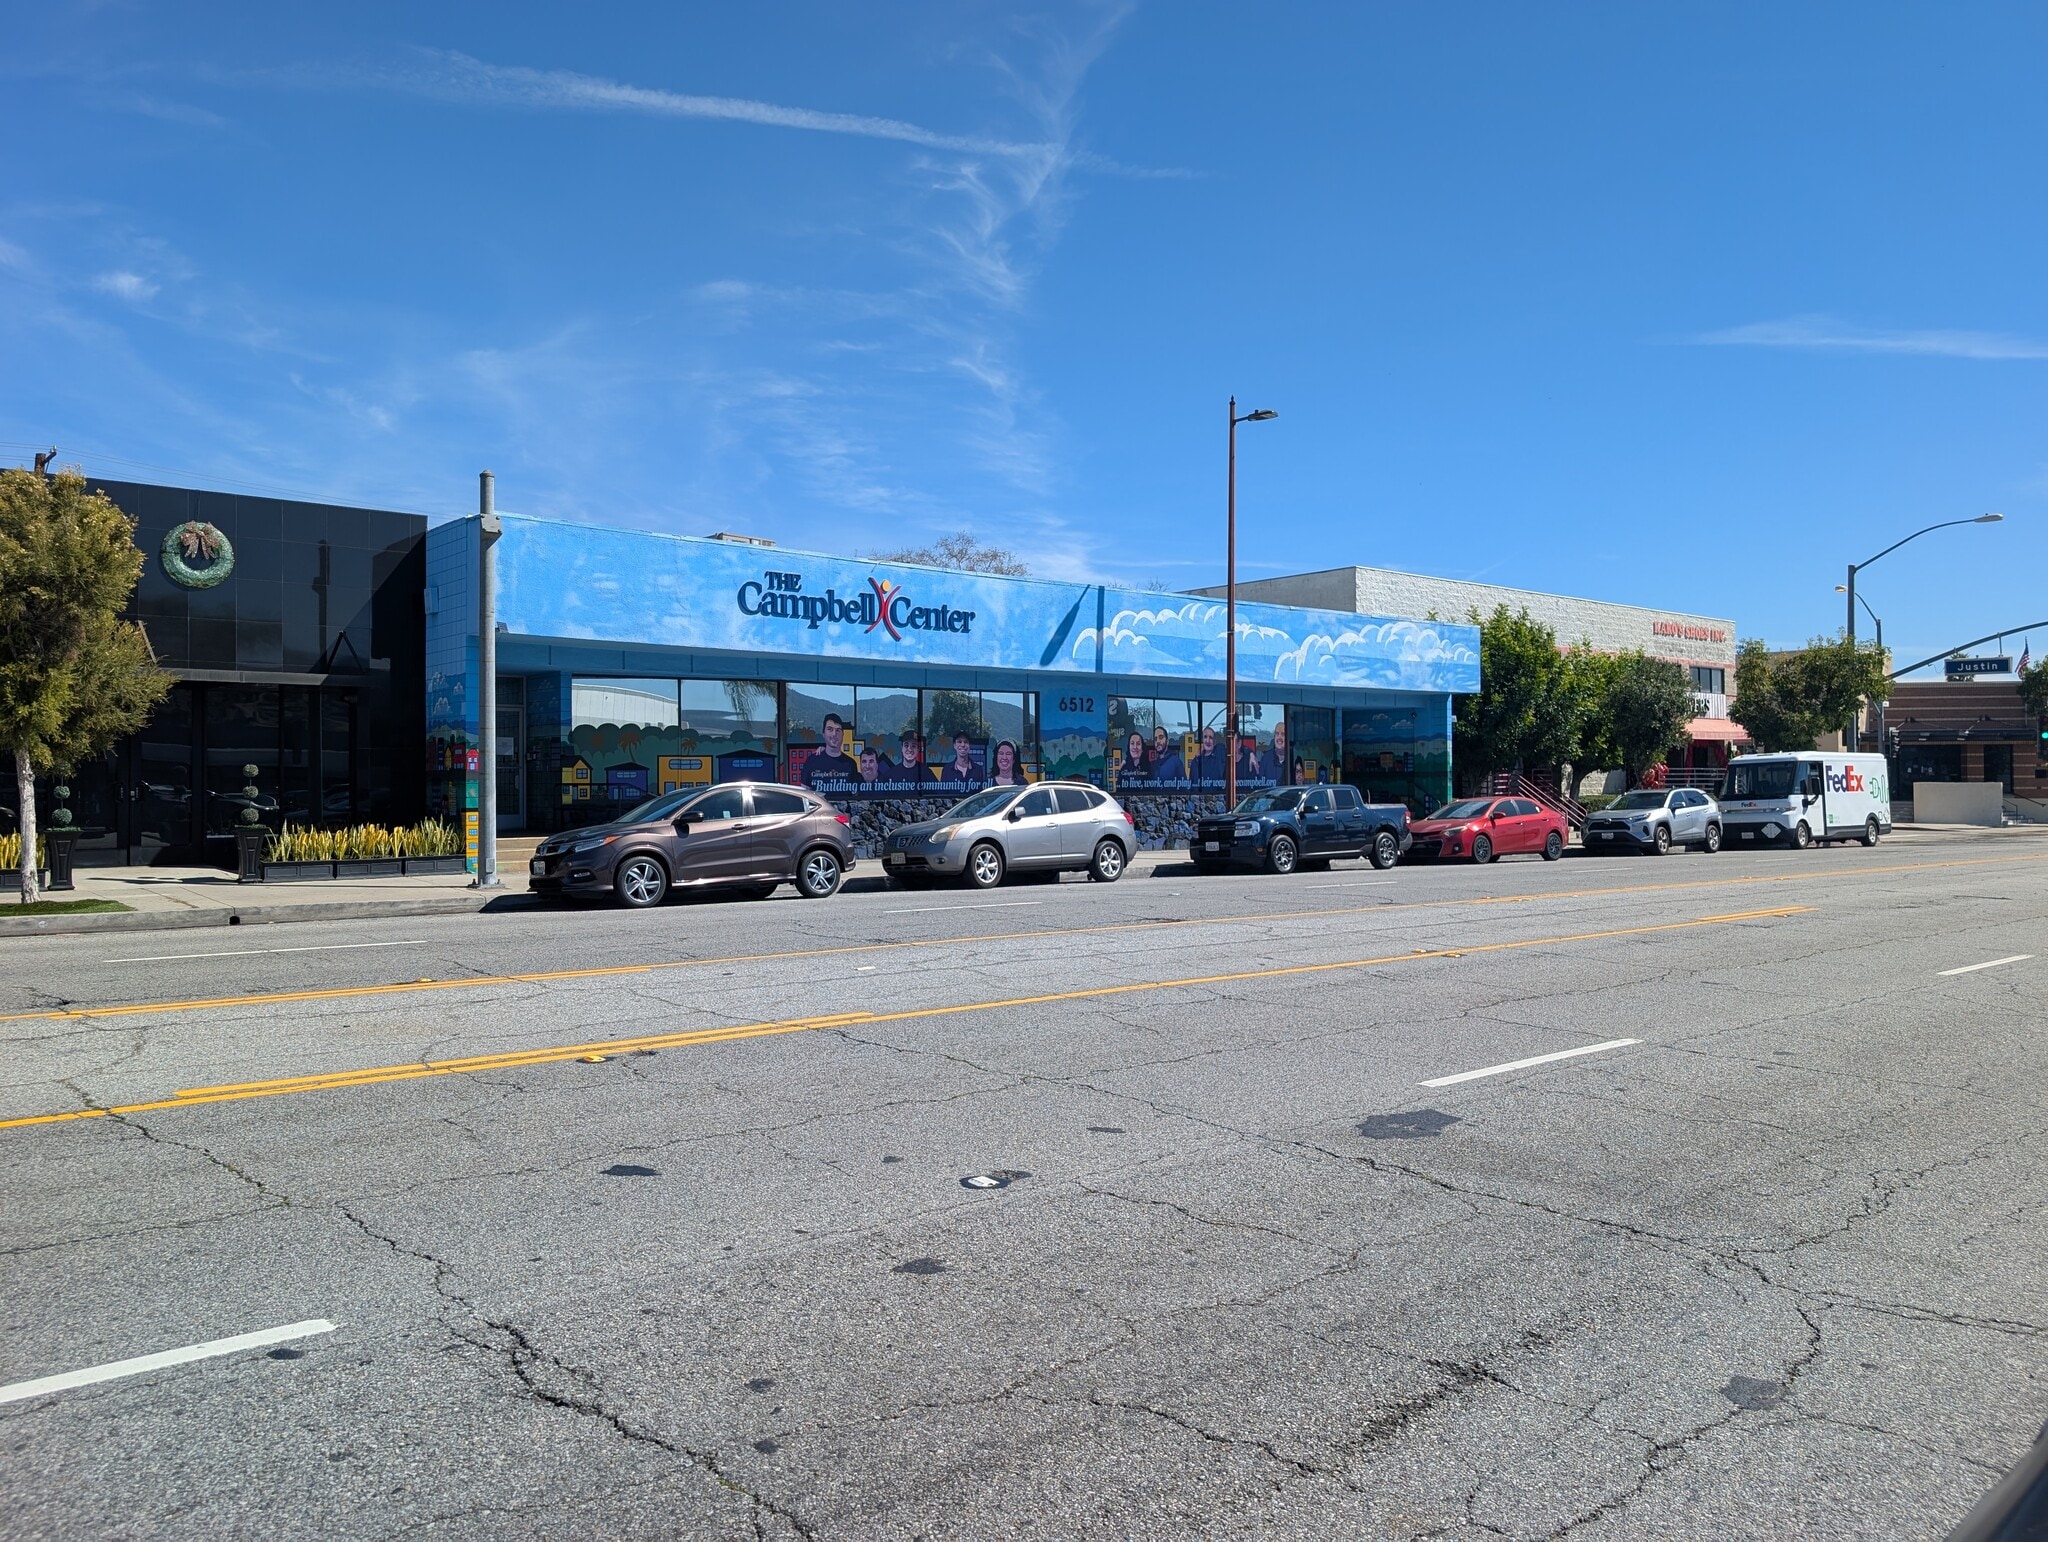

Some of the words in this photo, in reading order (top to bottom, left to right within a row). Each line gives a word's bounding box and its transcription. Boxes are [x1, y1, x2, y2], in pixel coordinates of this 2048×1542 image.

[764, 571, 802, 592] THE
[737, 581, 877, 629] Campbell
[889, 596, 976, 633] Center
[1684, 625, 1709, 640] SHOES
[1957, 662, 1998, 671] Justin
[1059, 697, 1094, 713] 6512
[860, 782, 873, 792] an
[875, 779, 915, 791] inclusive
[917, 779, 966, 792] community
[966, 778, 981, 792] for
[982, 778, 993, 789] all
[1129, 777, 1143, 789] live,
[1144, 777, 1163, 789] work,
[1164, 777, 1177, 788] and
[1177, 777, 1192, 790] play
[1213, 779, 1227, 789] way
[1825, 765, 1865, 792] FedEx
